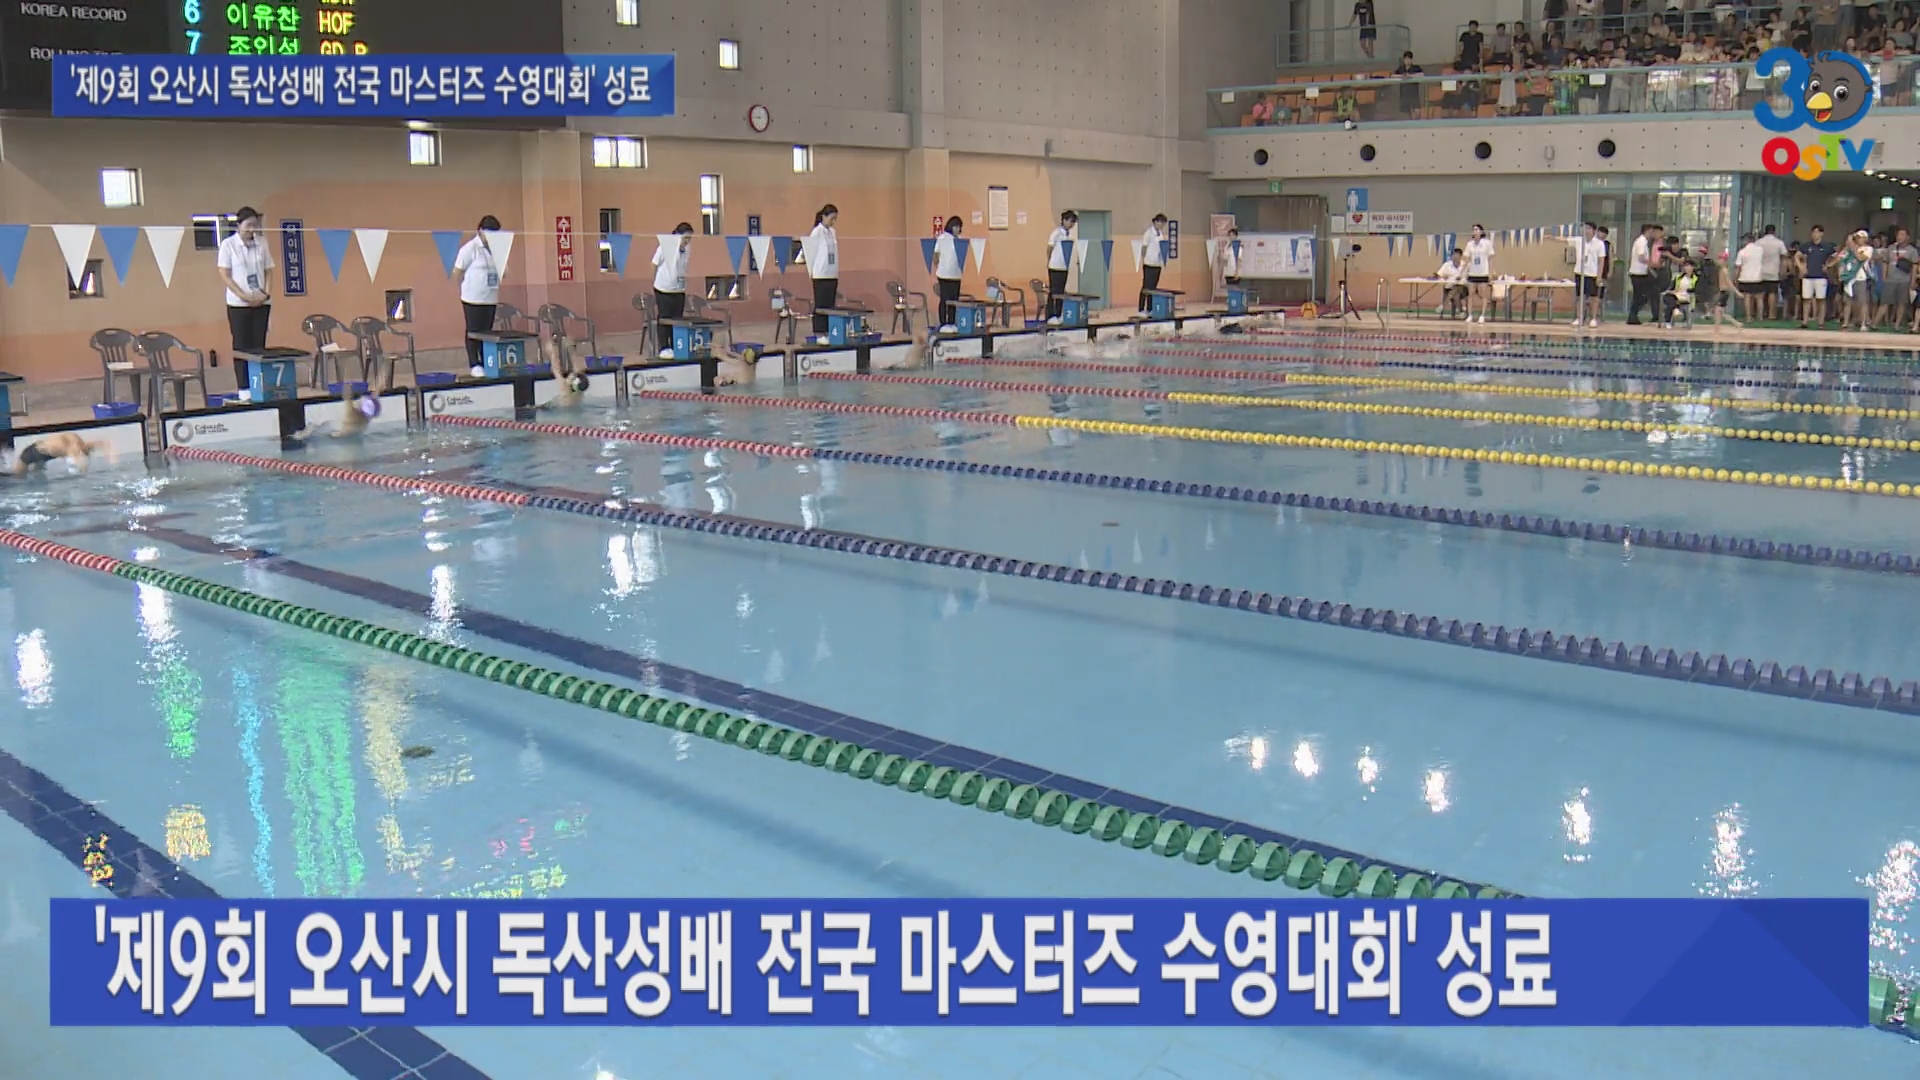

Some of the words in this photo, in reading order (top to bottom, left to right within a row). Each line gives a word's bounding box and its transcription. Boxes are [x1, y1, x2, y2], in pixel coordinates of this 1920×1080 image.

[20, 2, 69, 18] KOREA
[71, 6, 127, 21] RECORD
[184, 0, 200, 23] 6
[227, 2, 300, 31] 이유찬
[319, 10, 353, 34] HOF
[185, 30, 200, 55] 7
[506, 344, 518, 365] 6
[252, 376, 259, 390] 7
[271, 363, 286, 387] 7
